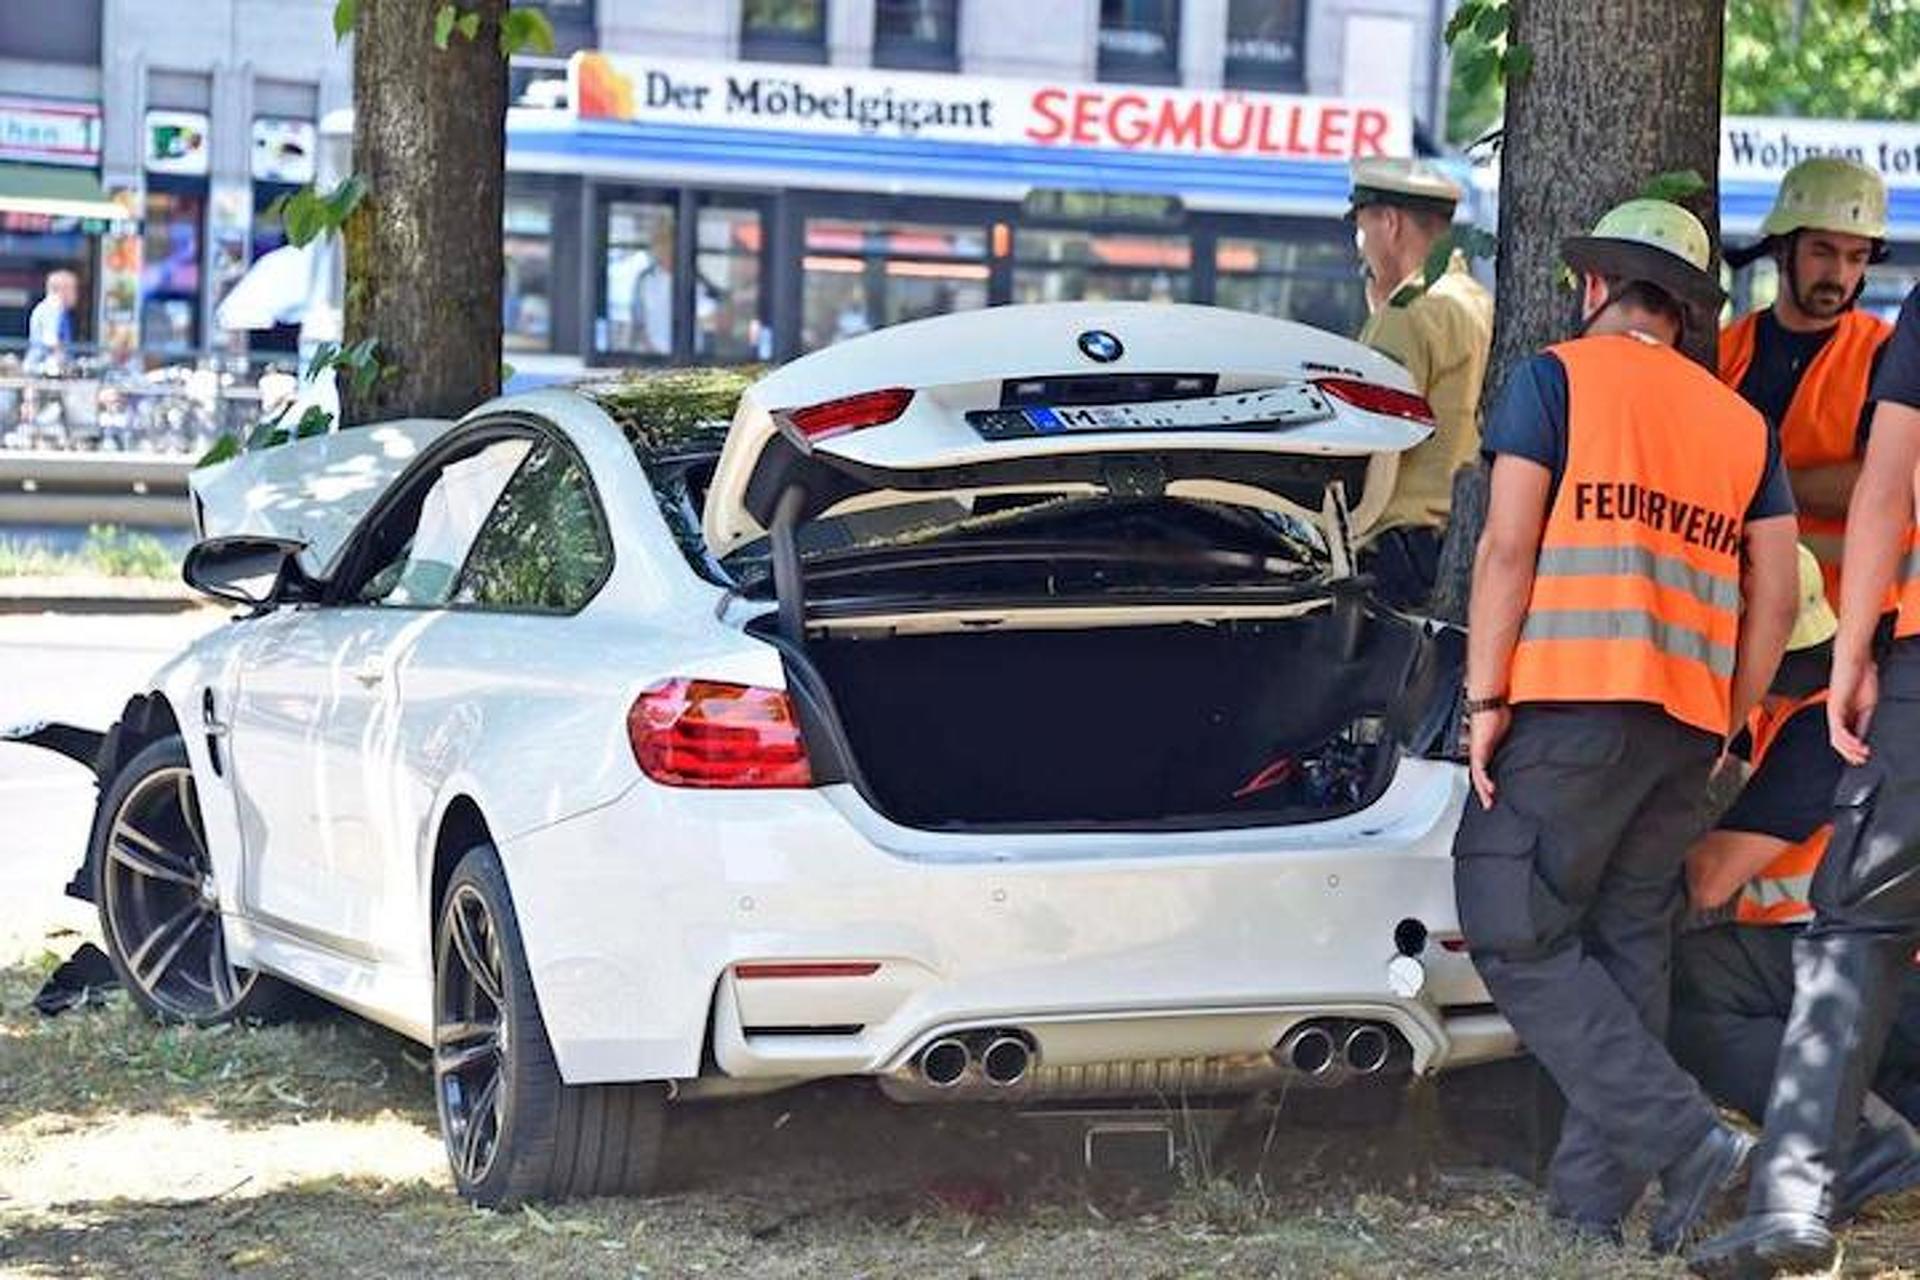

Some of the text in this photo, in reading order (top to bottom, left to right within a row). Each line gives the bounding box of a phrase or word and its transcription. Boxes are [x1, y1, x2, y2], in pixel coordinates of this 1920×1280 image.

[646, 70, 994, 132] Der Möbelgigant
[1025, 89, 1389, 159] SEGMÜLLER
